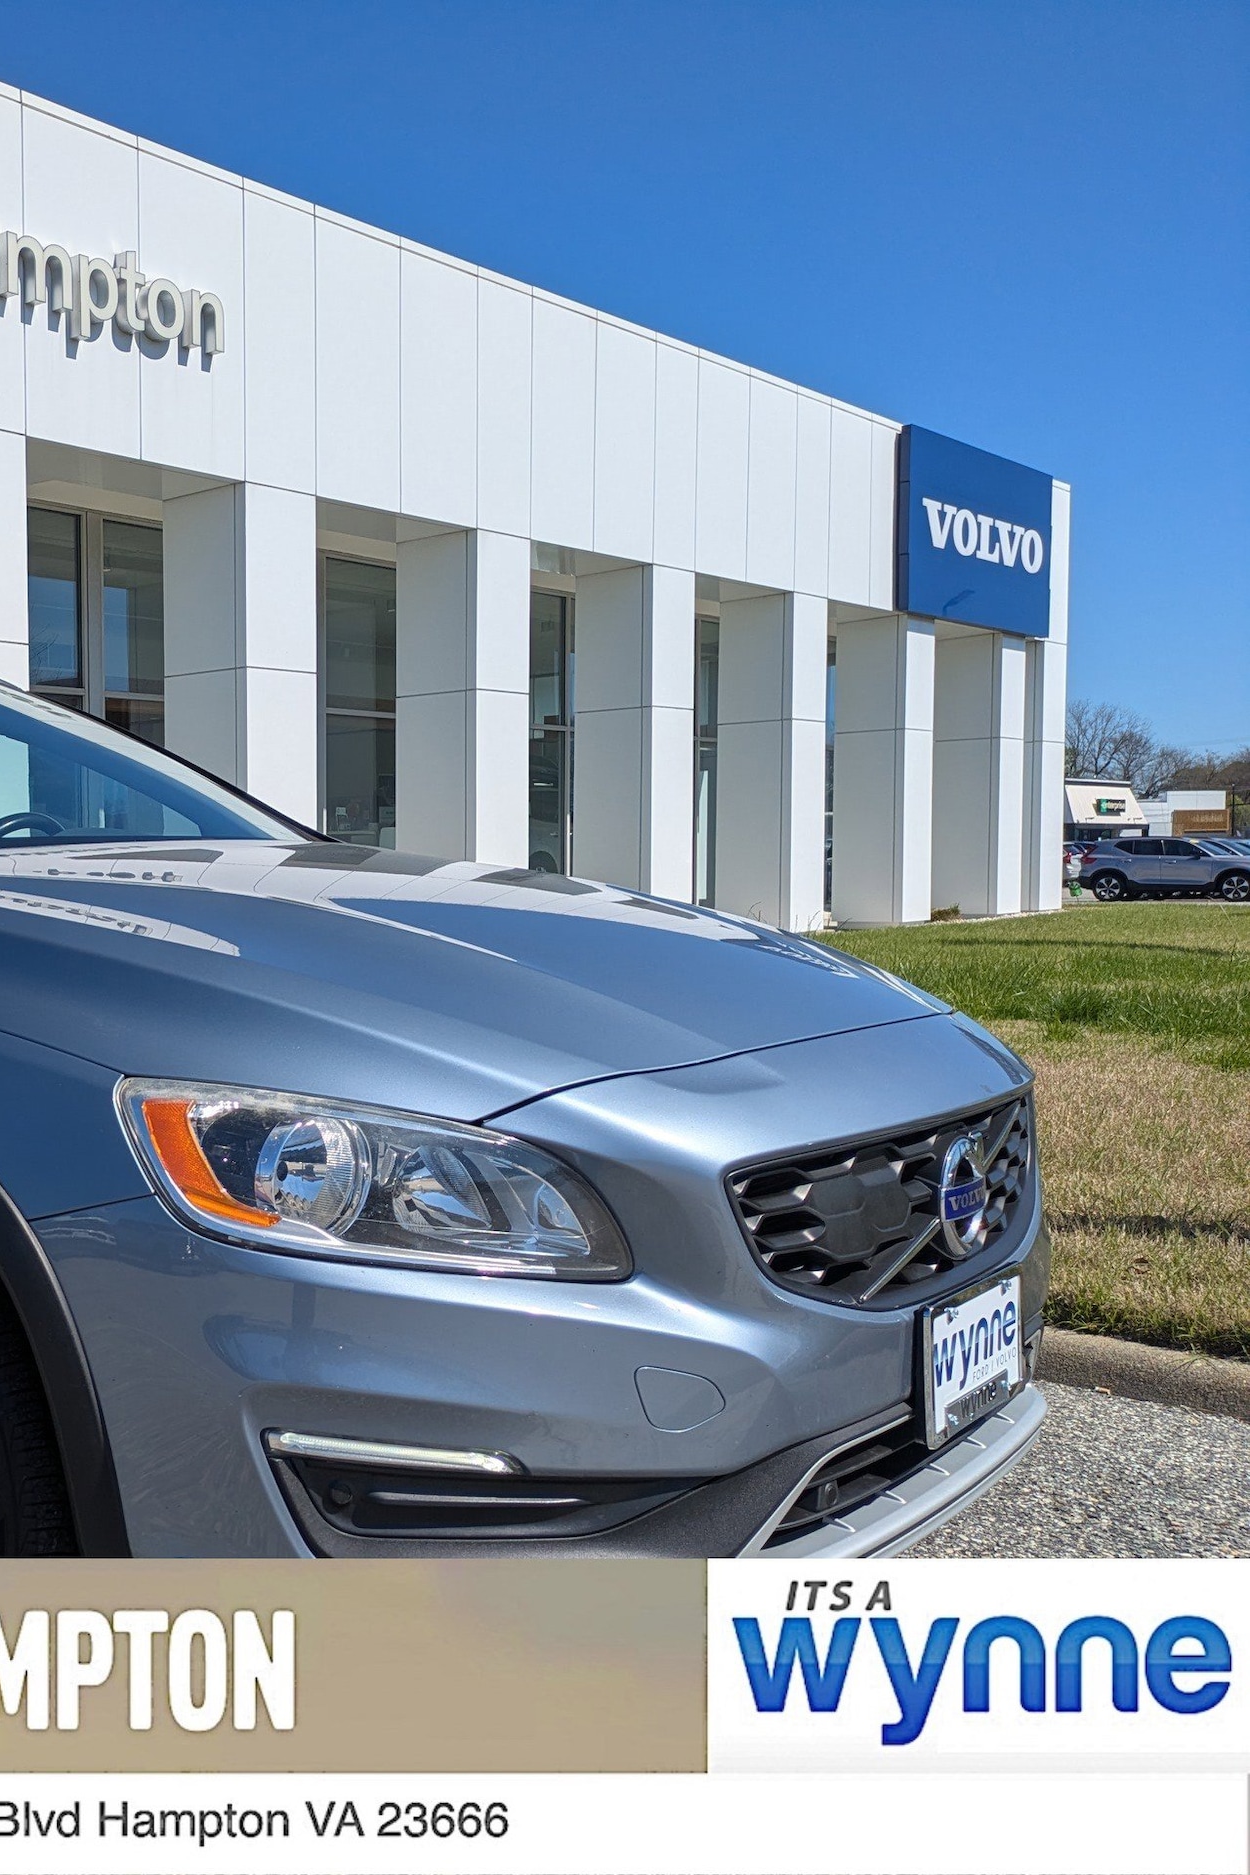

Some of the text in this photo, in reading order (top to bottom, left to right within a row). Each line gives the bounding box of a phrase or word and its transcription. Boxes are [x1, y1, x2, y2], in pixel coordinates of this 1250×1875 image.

[922, 497, 1044, 575] VOLVO
[933, 1300, 1017, 1391] wynne
[972, 1346, 1017, 1382] FORD VOLVO
[958, 1382, 997, 1419] wynne
